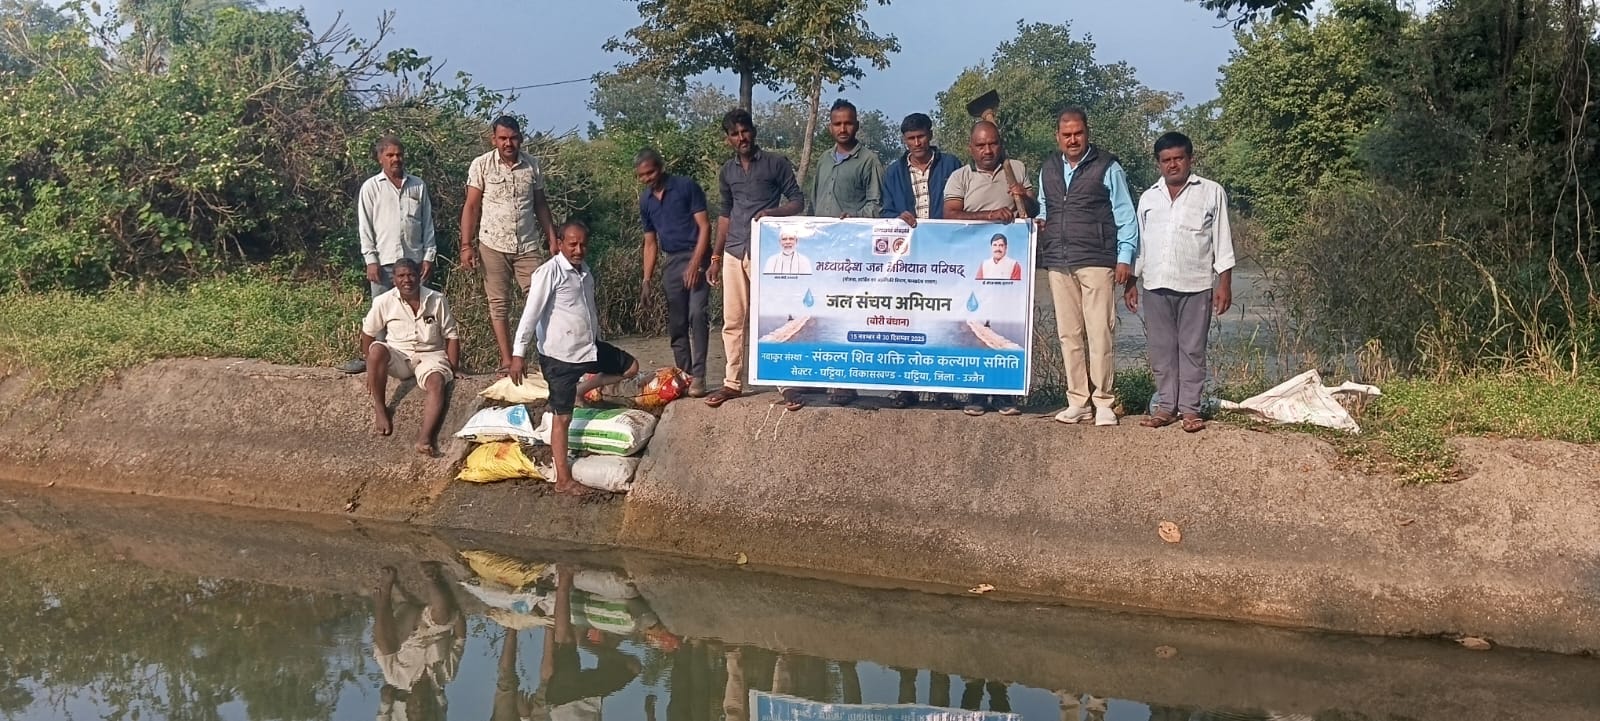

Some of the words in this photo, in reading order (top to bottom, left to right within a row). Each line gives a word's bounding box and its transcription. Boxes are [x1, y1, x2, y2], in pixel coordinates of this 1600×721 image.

[816, 258, 862, 274] मध्यप्रदेश
[866, 262, 883, 273] जन
[931, 261, 966, 278] परिषद्
[826, 294, 853, 308] जल
[856, 292, 892, 310] संचय
[896, 292, 952, 311] अभियान
[812, 349, 848, 363] संकल्प
[852, 349, 874, 364] शिव
[877, 350, 905, 365] शक्ति
[908, 351, 935, 366] लोक
[937, 355, 980, 367] कल्याण
[983, 355, 1020, 369] समिति
[791, 365, 813, 376] सेक्टर
[849, 367, 896, 379] विकासखण्ड
[934, 370, 954, 382] जिला
[963, 371, 985, 383] उज्जैन
